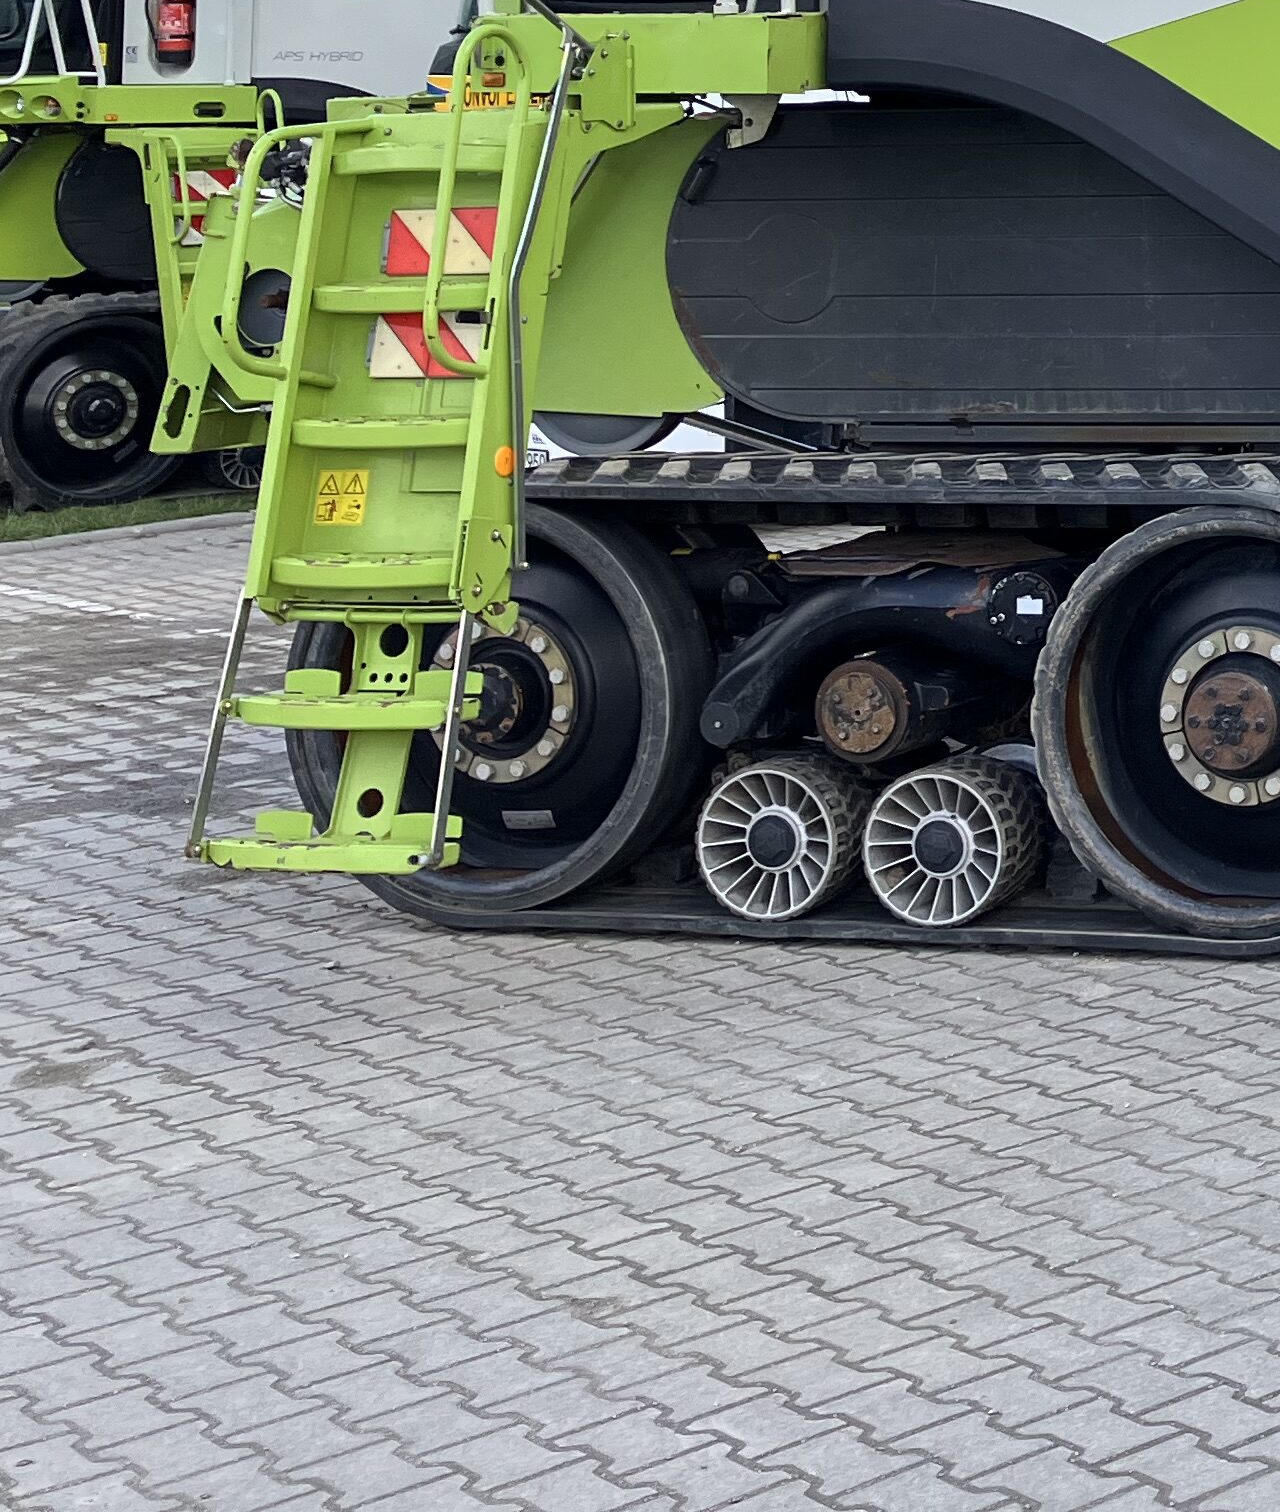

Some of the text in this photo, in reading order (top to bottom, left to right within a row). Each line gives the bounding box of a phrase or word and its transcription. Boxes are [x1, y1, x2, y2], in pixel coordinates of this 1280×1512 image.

[272, 50, 364, 62] APS HYBRID
[452, 82, 500, 107] ONVOI
